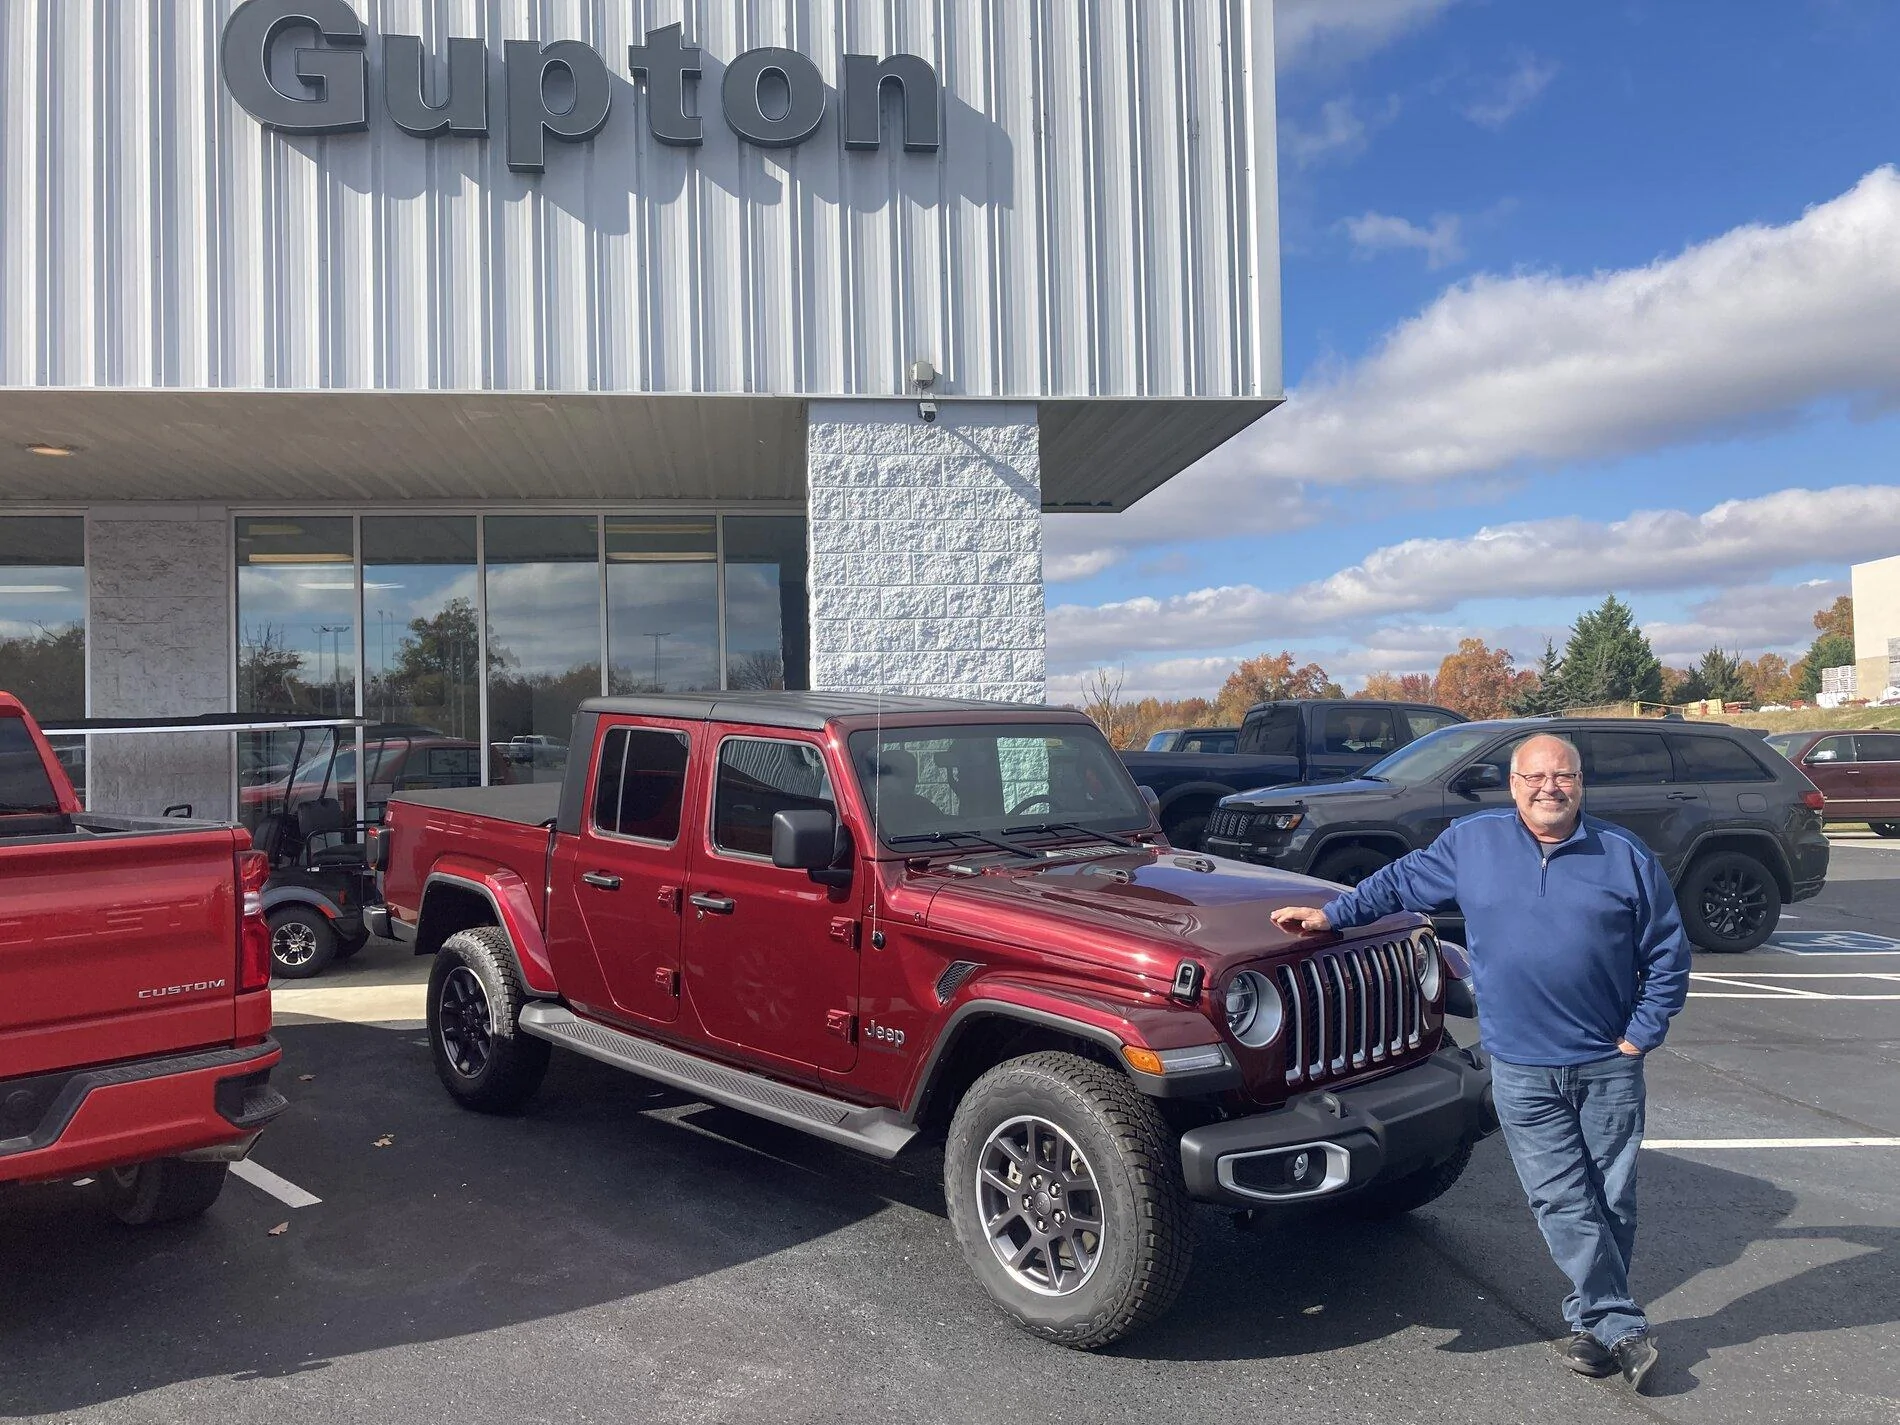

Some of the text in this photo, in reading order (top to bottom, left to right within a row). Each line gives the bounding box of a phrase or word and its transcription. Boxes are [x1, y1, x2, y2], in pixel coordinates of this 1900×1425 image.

[221, 0, 941, 173] Gupton
[138, 979, 226, 999] CUSTOM
[864, 1019, 905, 1048] Jeep
